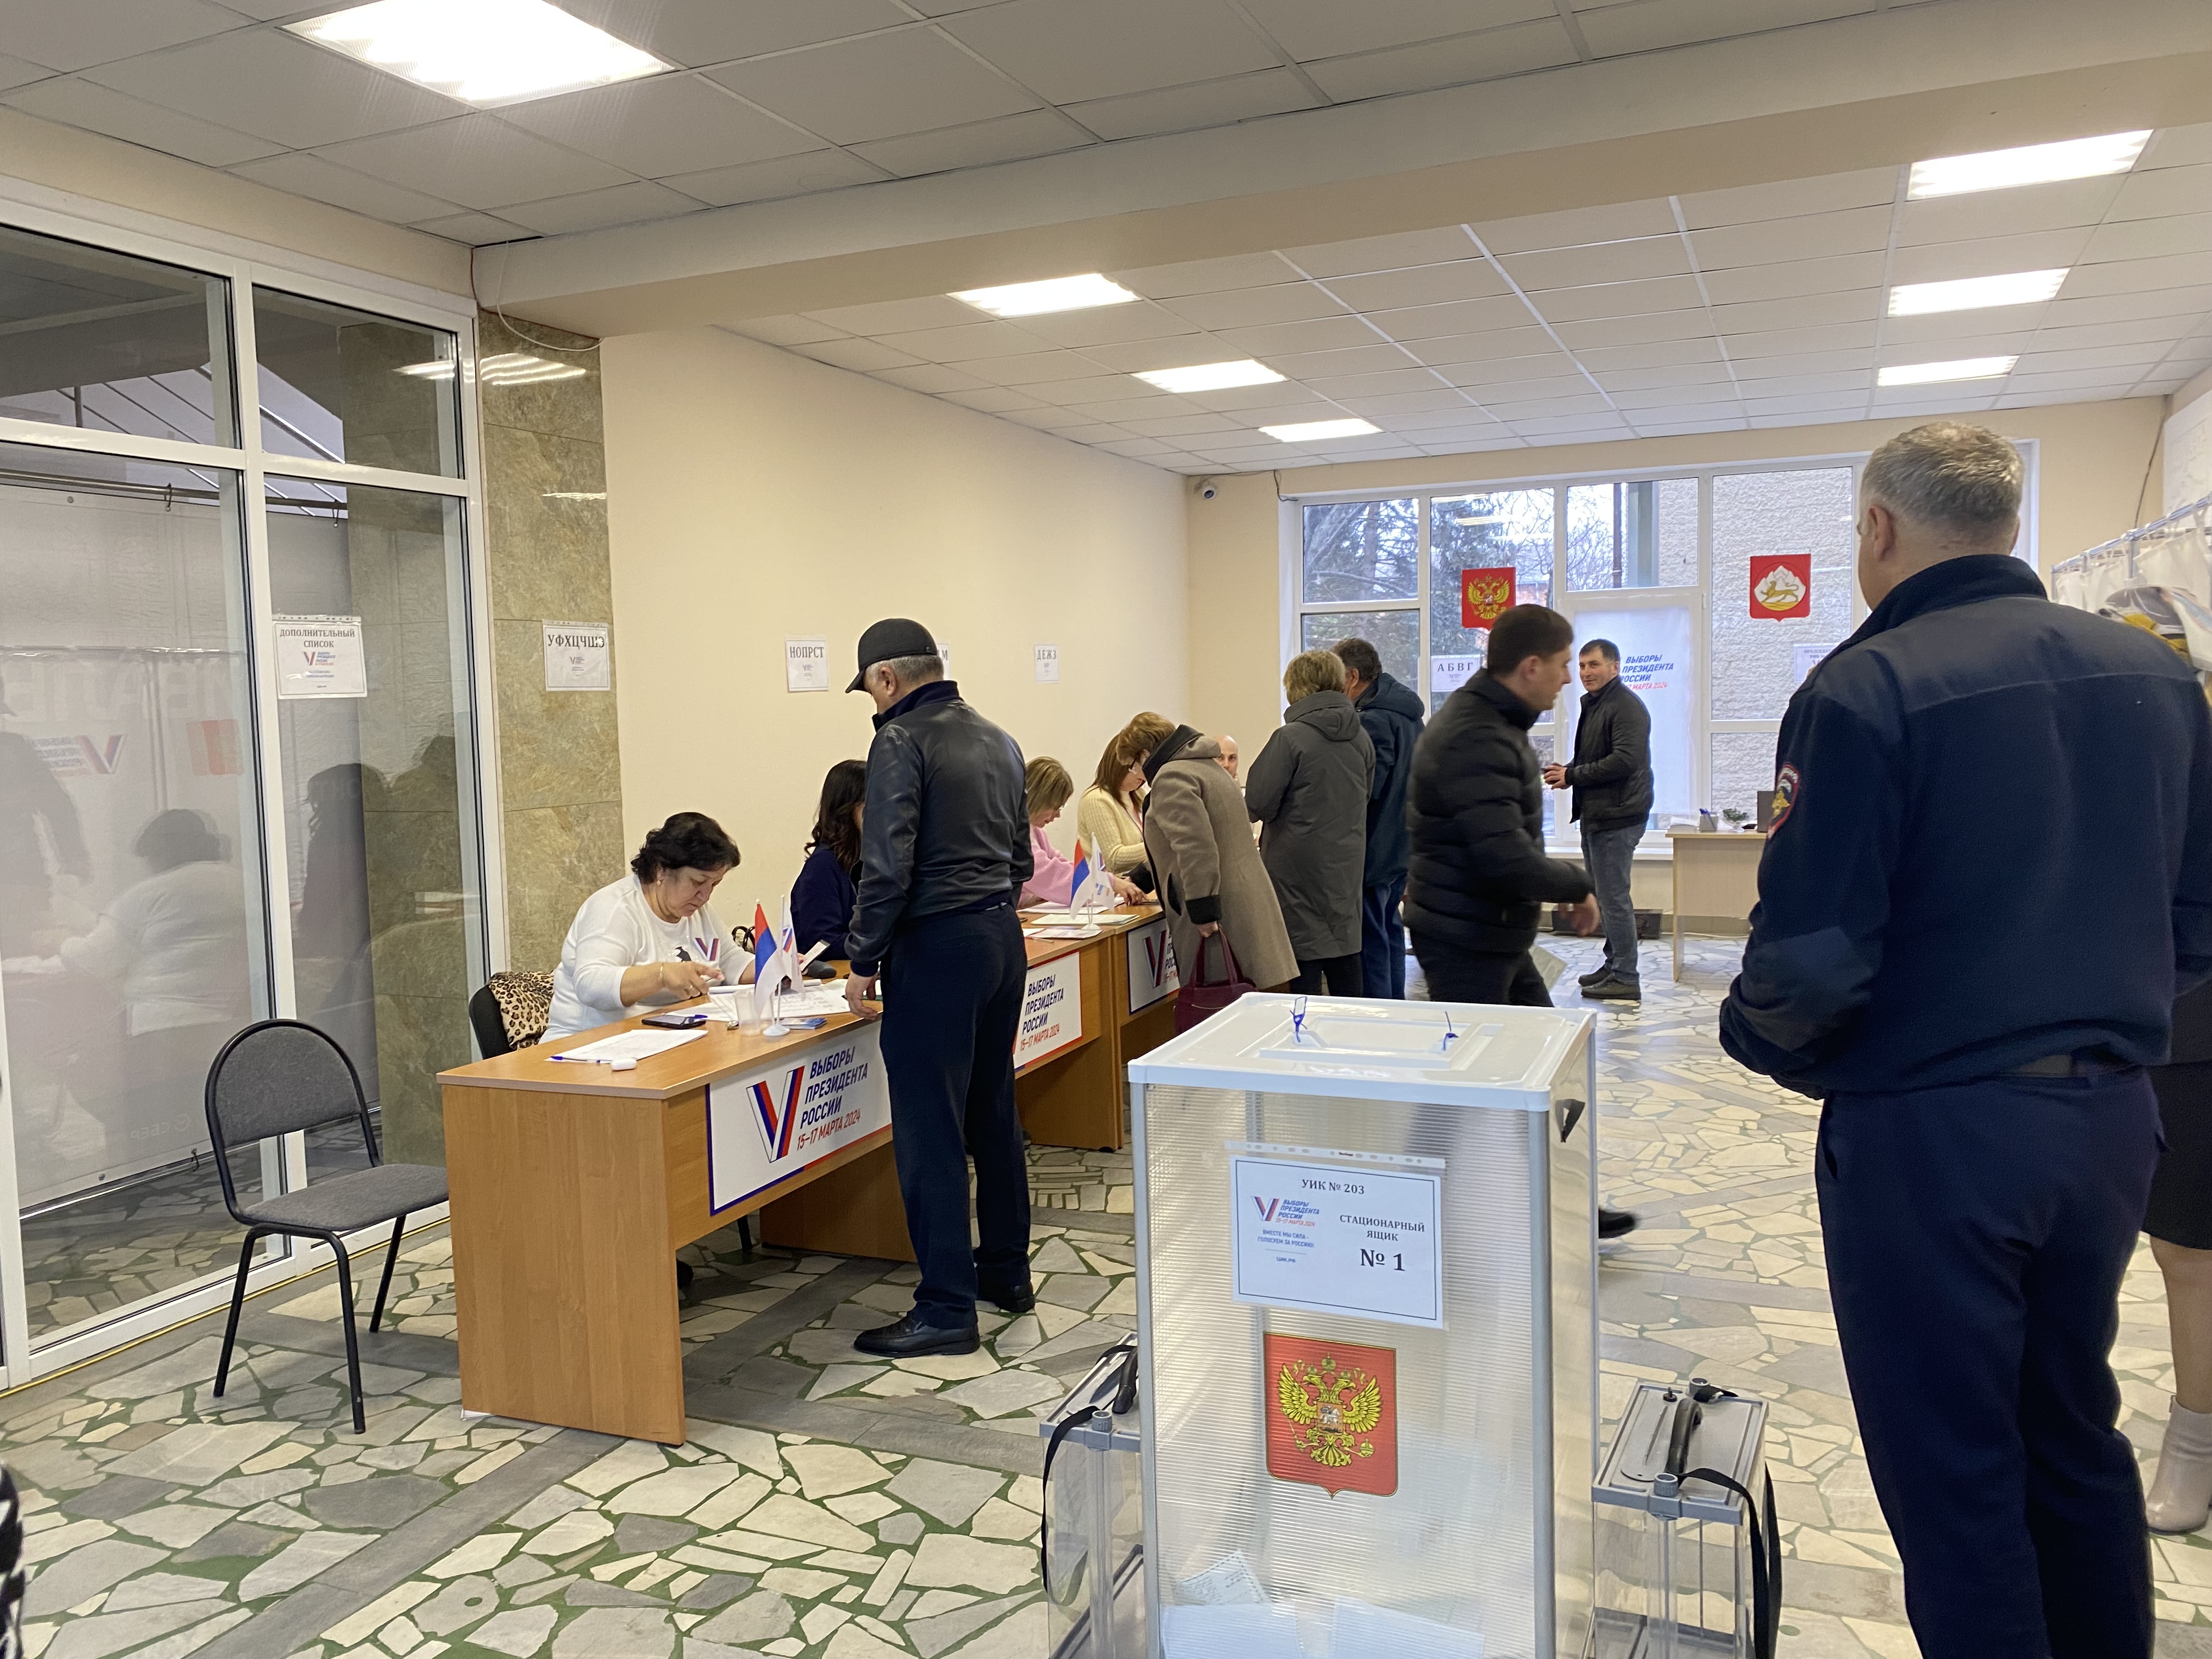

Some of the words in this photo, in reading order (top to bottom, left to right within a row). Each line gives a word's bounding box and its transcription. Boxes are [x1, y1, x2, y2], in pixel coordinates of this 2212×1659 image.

[280, 629, 355, 637] ДОПОЛНИТЕЛЬНЫЙ
[790, 646, 824, 658] НОПРСТ
[1037, 650, 1056, 662] ДЕЖЗ
[1626, 654, 1662, 663] ВЫБОРЫ
[1622, 663, 1674, 673] ПРЕЗИДЕНТА
[1028, 974, 1056, 997] ВЫБОРЫ
[1025, 988, 1064, 1016] ПРЕЗИДЕНТА
[1022, 1012, 1048, 1035] РОССИИ
[1034, 1028, 1049, 1045] МАРТА
[809, 1046, 855, 1079] ВЫБОРЫ
[805, 1063, 868, 1104] ПРЕЗИДЕНТА
[800, 1095, 842, 1129] РОССИИ
[818, 1116, 843, 1141] МАРТА
[843, 1108, 861, 1129] 2024
[1302, 1179, 1326, 1190] УИК
[1329, 1182, 1341, 1191] №
[1344, 1184, 1364, 1194] 203
[1280, 1205, 1319, 1215] ПРЕЗИДЕНТА
[1340, 1215, 1425, 1232] СТАЦИОНАРНЫЙ
[1367, 1231, 1398, 1241] ЯЩИК
[1360, 1248, 1385, 1267] №
[1393, 1253, 1405, 1271] 1
